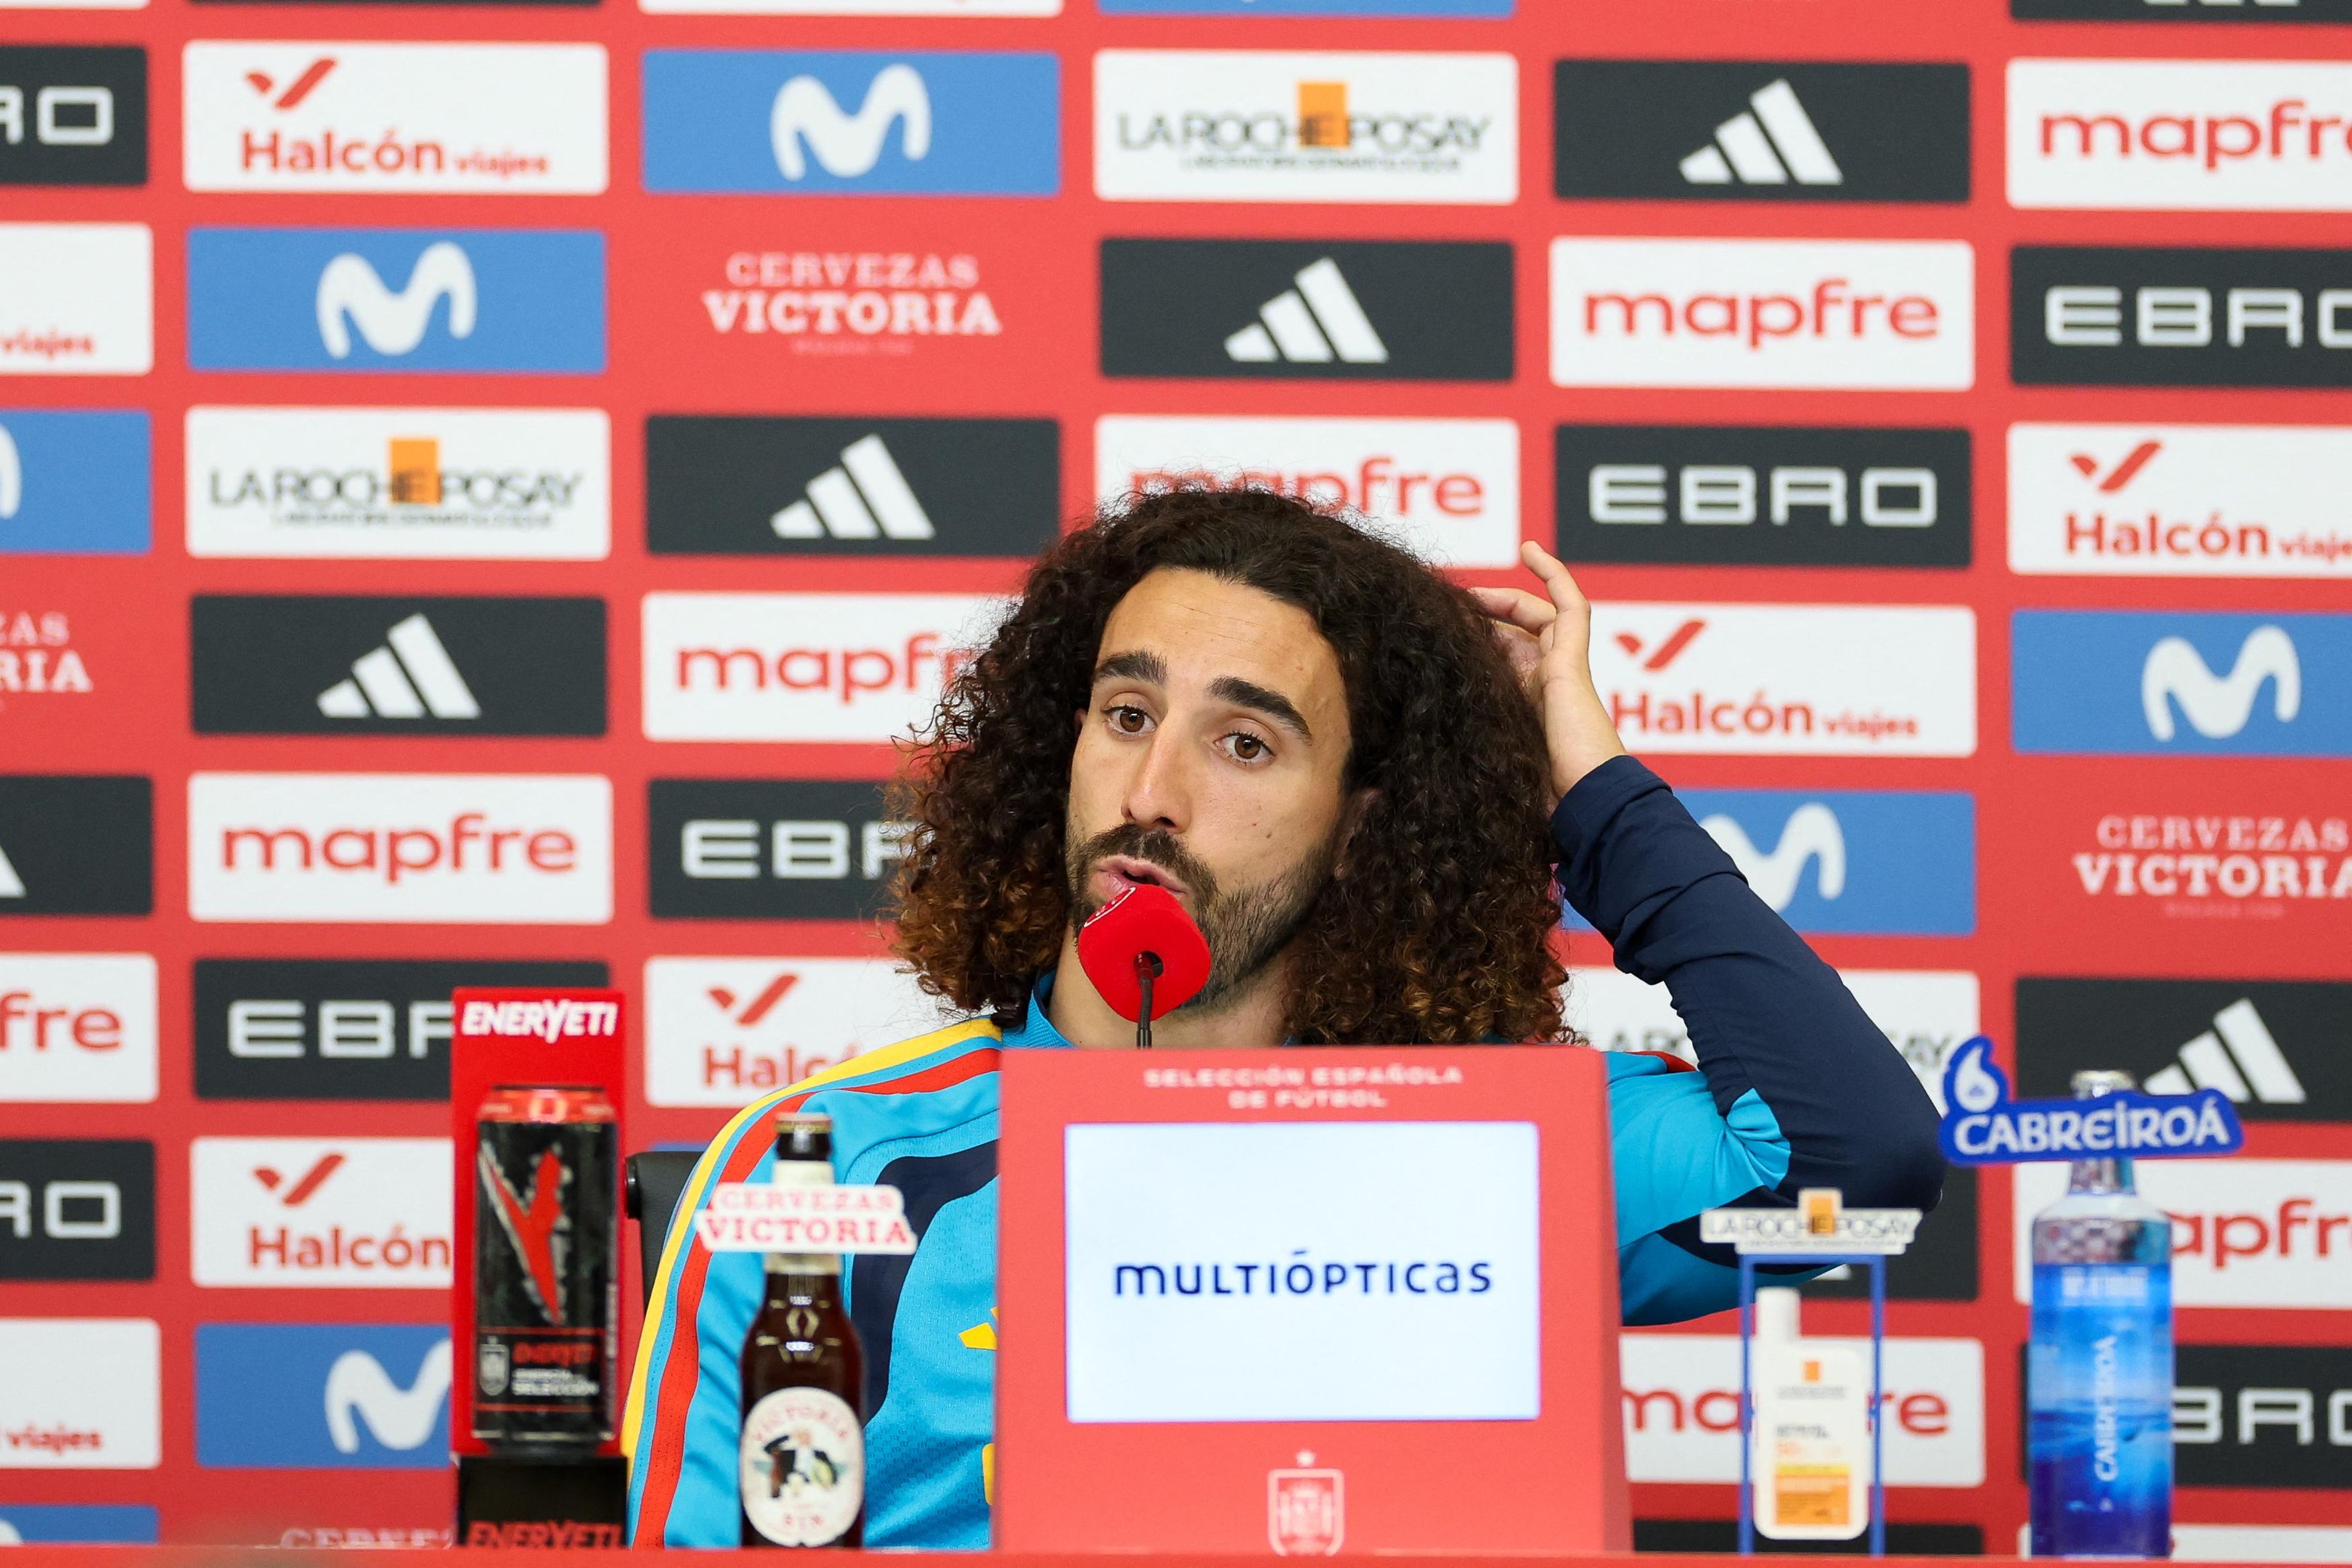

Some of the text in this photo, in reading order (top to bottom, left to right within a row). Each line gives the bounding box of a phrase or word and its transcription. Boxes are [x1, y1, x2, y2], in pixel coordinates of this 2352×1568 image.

[1117, 112, 1175, 150] LA
[2039, 99, 2352, 172] mapfr
[242, 129, 550, 179] Halcón viajes
[727, 252, 979, 288] CERVEZAS
[702, 291, 1002, 335] VICTORIA
[1584, 278, 1940, 351] mapfre
[0, 327, 95, 360] viajes
[209, 468, 265, 506] LA
[1589, 465, 1937, 527] EBRO
[2065, 513, 2270, 557] Halcón
[677, 632, 974, 703] mapfr
[1609, 690, 1919, 740] Halcón viajes
[221, 812, 577, 886] mapfre
[682, 819, 933, 880] EBR
[2096, 815, 2349, 852] CERVEZAS
[461, 998, 618, 1044] ENERYETI
[703, 1044, 858, 1086] Halc
[1143, 1062, 1464, 1088] SELECCIÓN ESPAÑOLA
[1228, 1087, 1389, 1110] DE FÚTBOL
[719, 1190, 895, 1211] CERVEZAS
[250, 1225, 450, 1268] Halcón
[704, 1216, 911, 1245] VICTORIA
[2165, 1198, 2351, 1271] apfr
[6, 1425, 102, 1456] viajes
